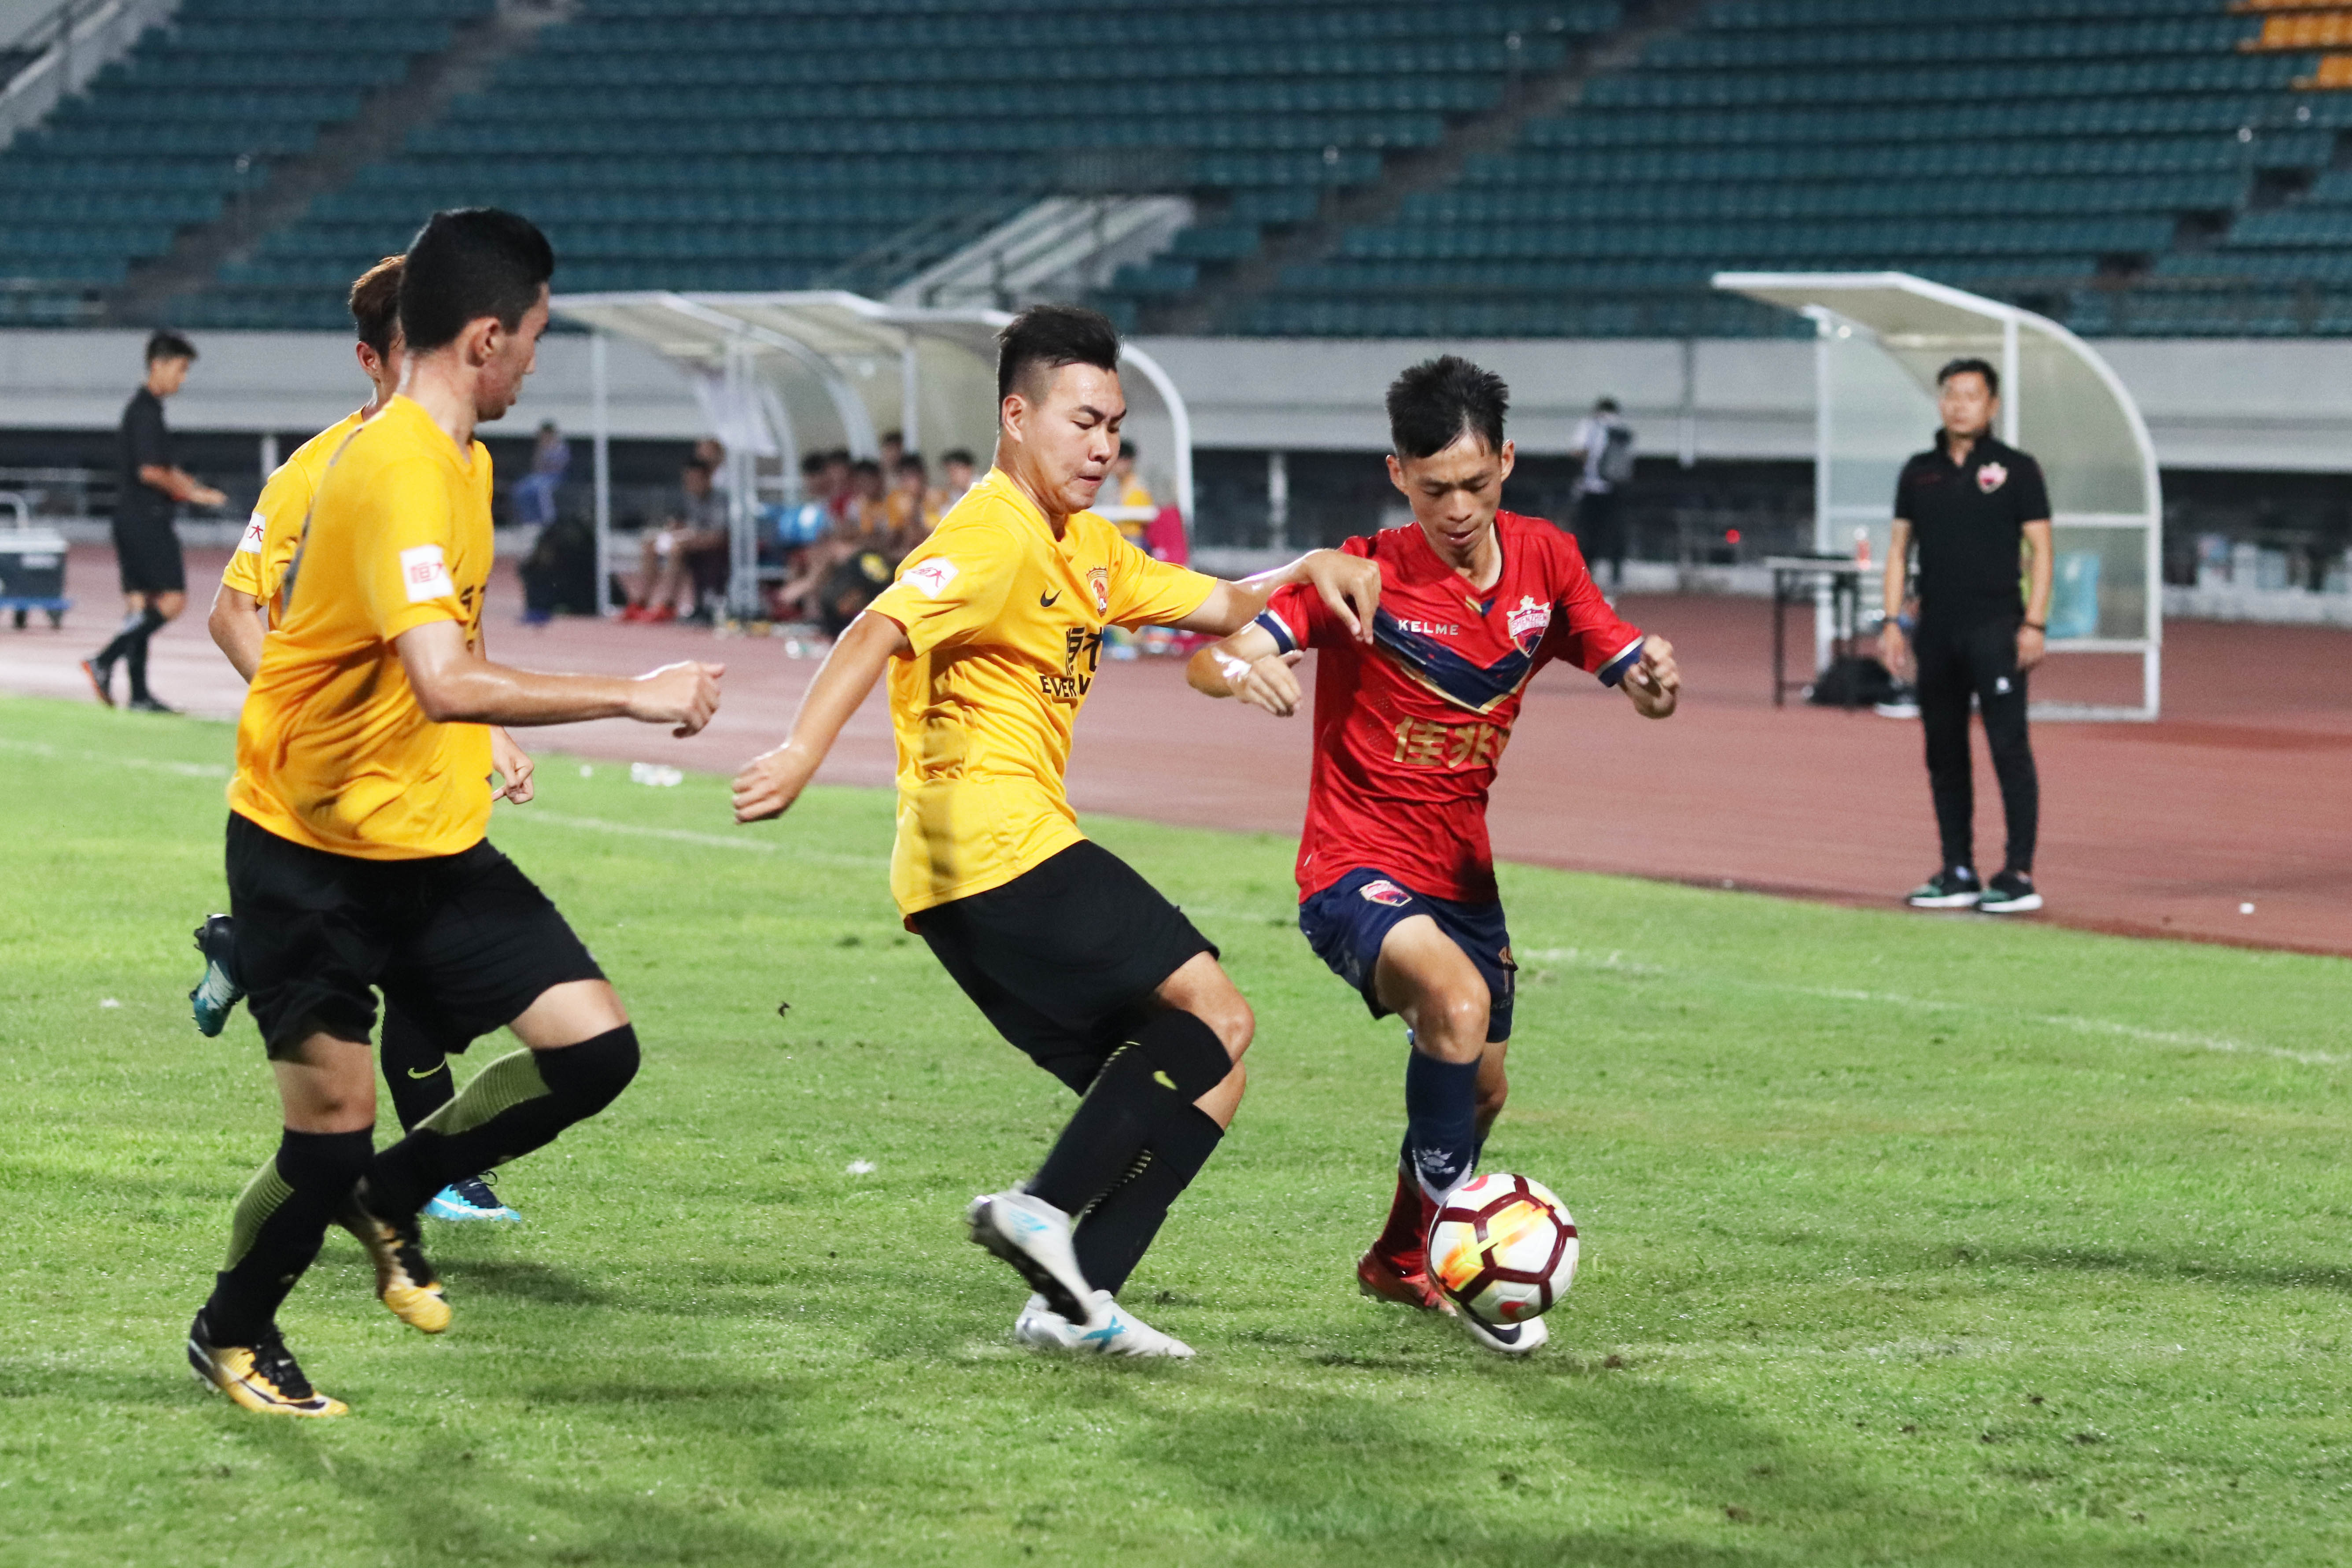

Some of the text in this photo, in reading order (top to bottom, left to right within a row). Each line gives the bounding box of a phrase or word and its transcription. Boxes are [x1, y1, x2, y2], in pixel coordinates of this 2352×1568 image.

[246, 525, 263, 542] 大
[1398, 619, 1459, 635] KELME
[1393, 715, 1509, 769] 佳兆
